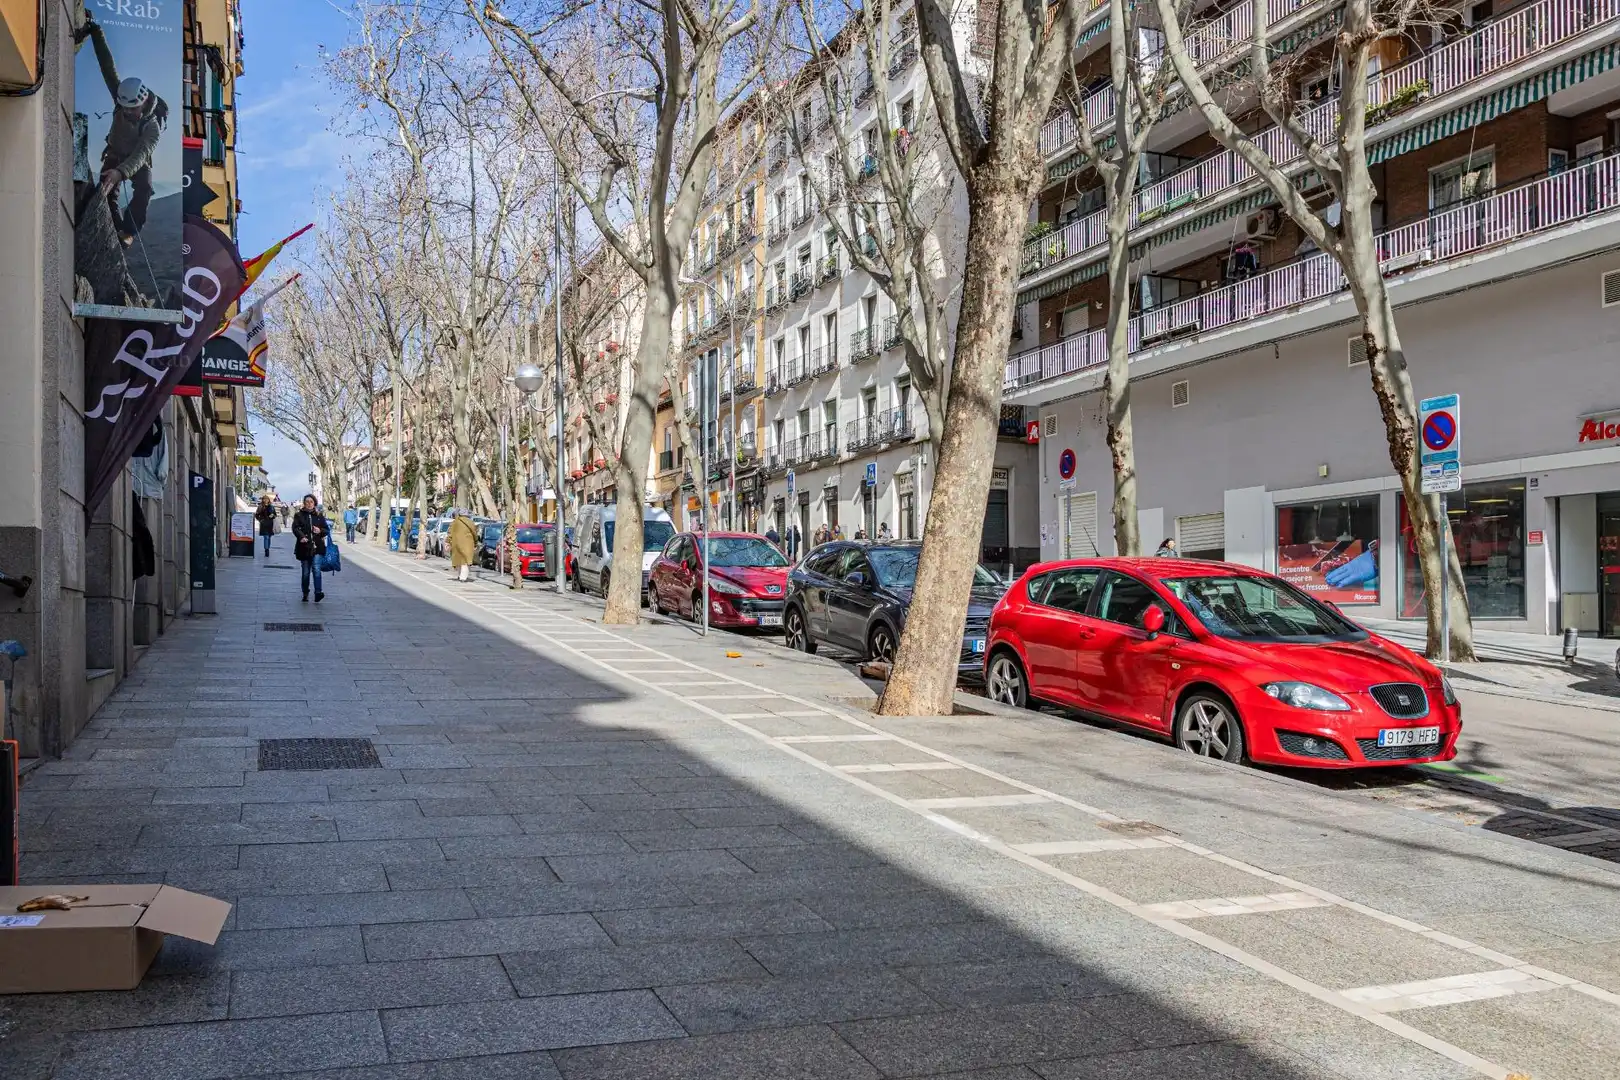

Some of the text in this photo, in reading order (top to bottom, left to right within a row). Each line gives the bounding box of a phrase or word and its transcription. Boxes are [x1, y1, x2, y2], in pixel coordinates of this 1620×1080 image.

[115, 0, 160, 20] Rab
[103, 19, 143, 29] MOUNTAIN
[1578, 418, 1620, 443] Alc
[193, 476, 204, 488] P
[1387, 727, 1438, 744] 9179 HFB
